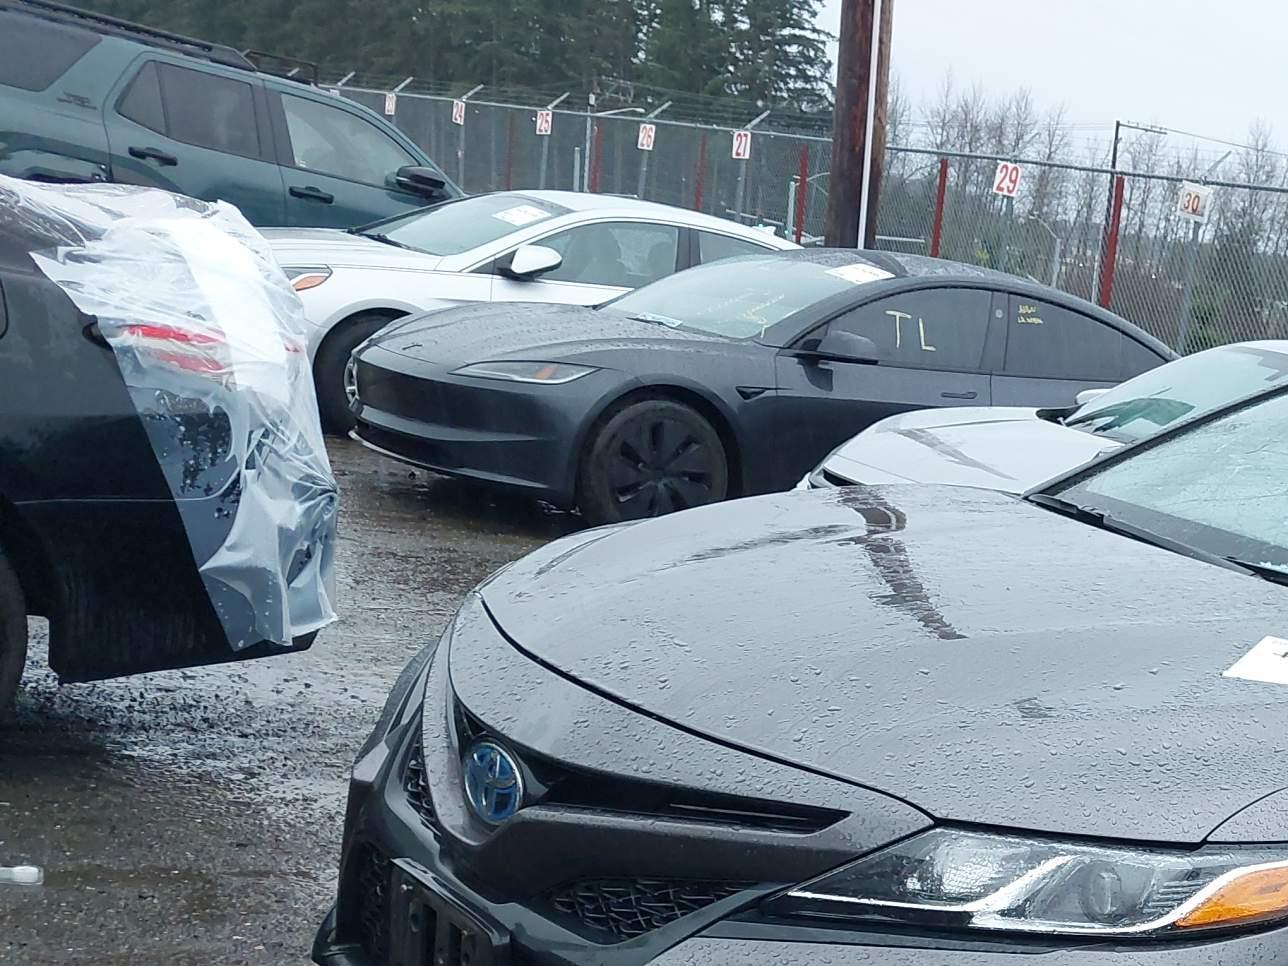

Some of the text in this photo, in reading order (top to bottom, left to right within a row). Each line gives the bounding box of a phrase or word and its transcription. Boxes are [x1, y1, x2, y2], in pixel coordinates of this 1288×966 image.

[454, 101, 465, 122] 24
[538, 112, 551, 133] 25
[639, 125, 654, 148] 26
[735, 132, 748, 157] 27
[995, 163, 1020, 195] 29
[1182, 191, 1200, 213] 30
